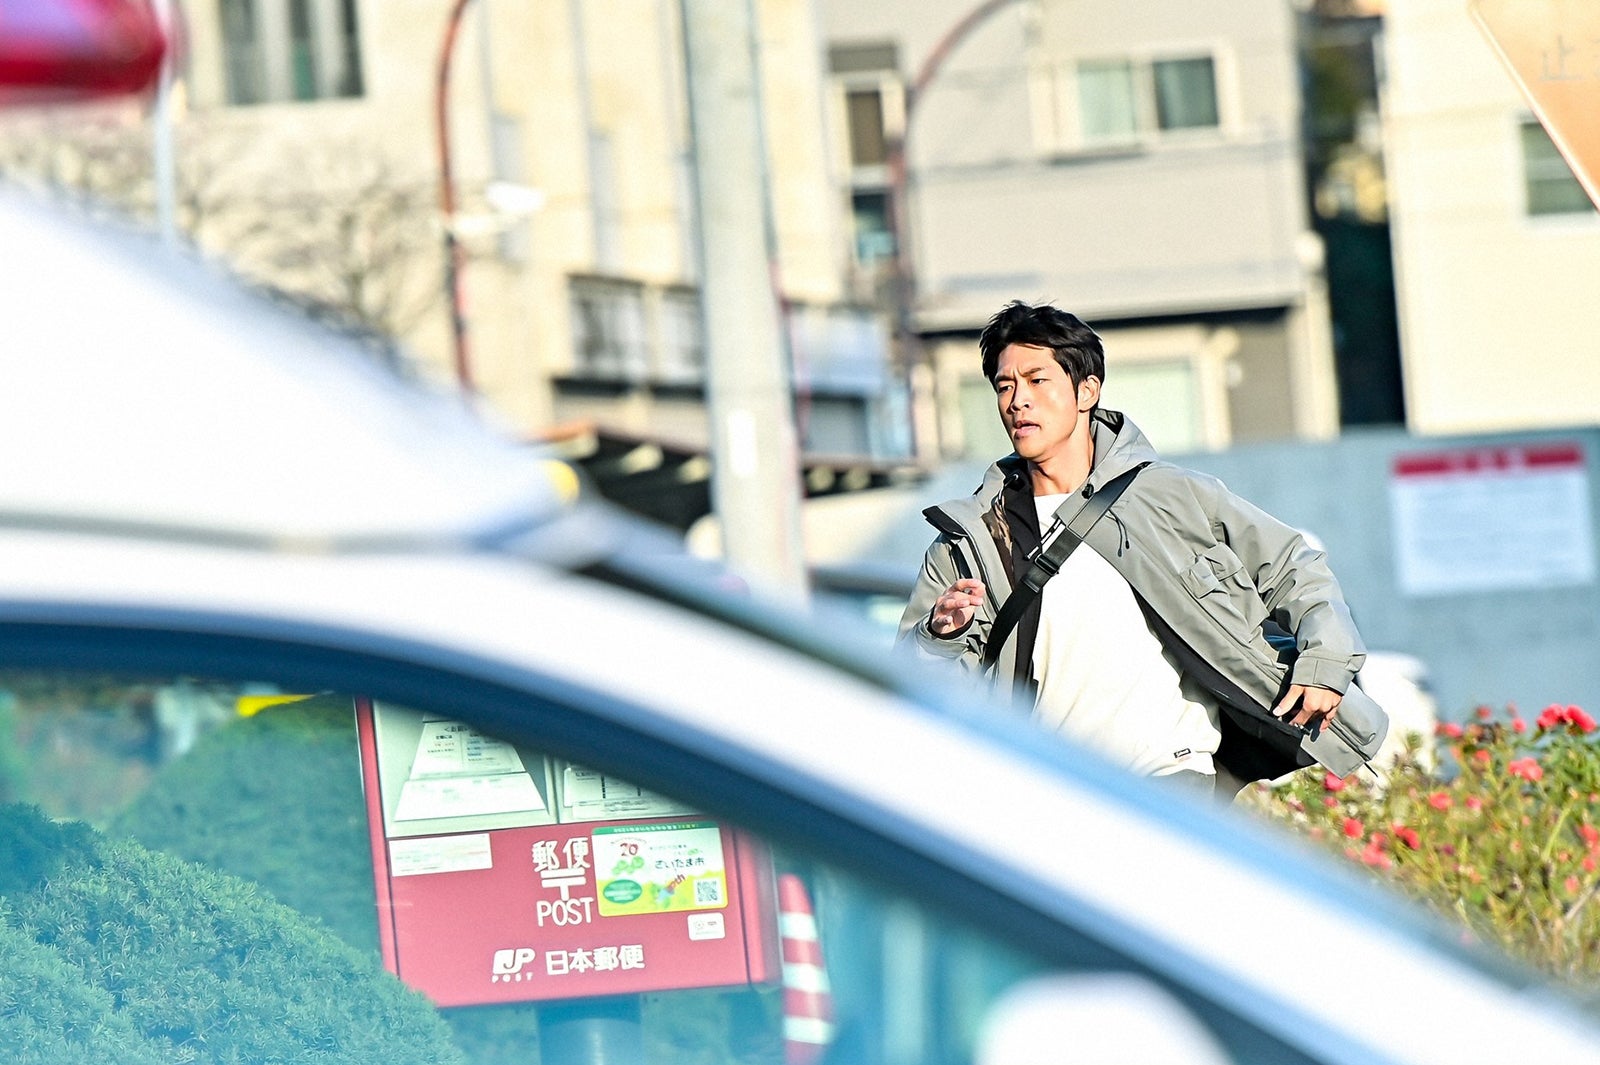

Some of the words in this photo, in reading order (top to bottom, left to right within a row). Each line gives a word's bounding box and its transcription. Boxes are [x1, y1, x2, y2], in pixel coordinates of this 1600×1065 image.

[531, 837, 591, 872] 郵便
[655, 857, 705, 869] さいたま市
[536, 897, 594, 927] POST
[545, 944, 645, 975] 日本郵便
[491, 973, 534, 983] POST
